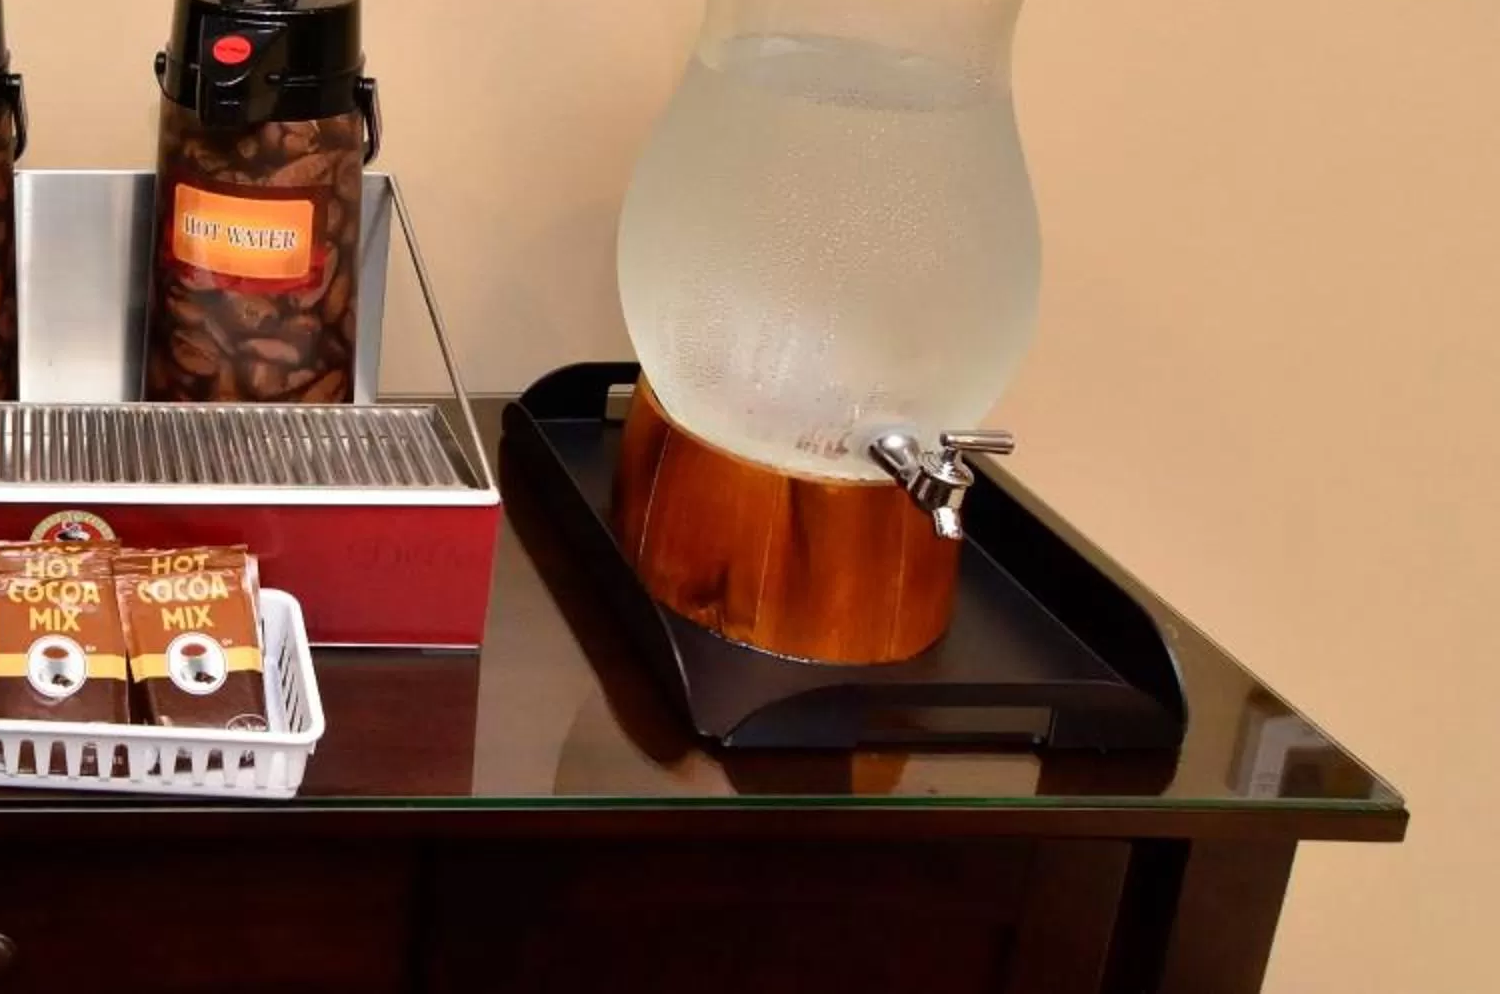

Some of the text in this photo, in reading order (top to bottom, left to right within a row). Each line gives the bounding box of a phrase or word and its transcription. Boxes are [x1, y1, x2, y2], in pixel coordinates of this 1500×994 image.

[185, 214, 296, 249] HOT WATER
[25, 557, 83, 578] HOT
[151, 554, 210, 575] HOT
[7, 579, 100, 604] COCOA
[137, 573, 229, 604] COCOA
[29, 607, 80, 632] MIX
[161, 605, 214, 632] MIX
